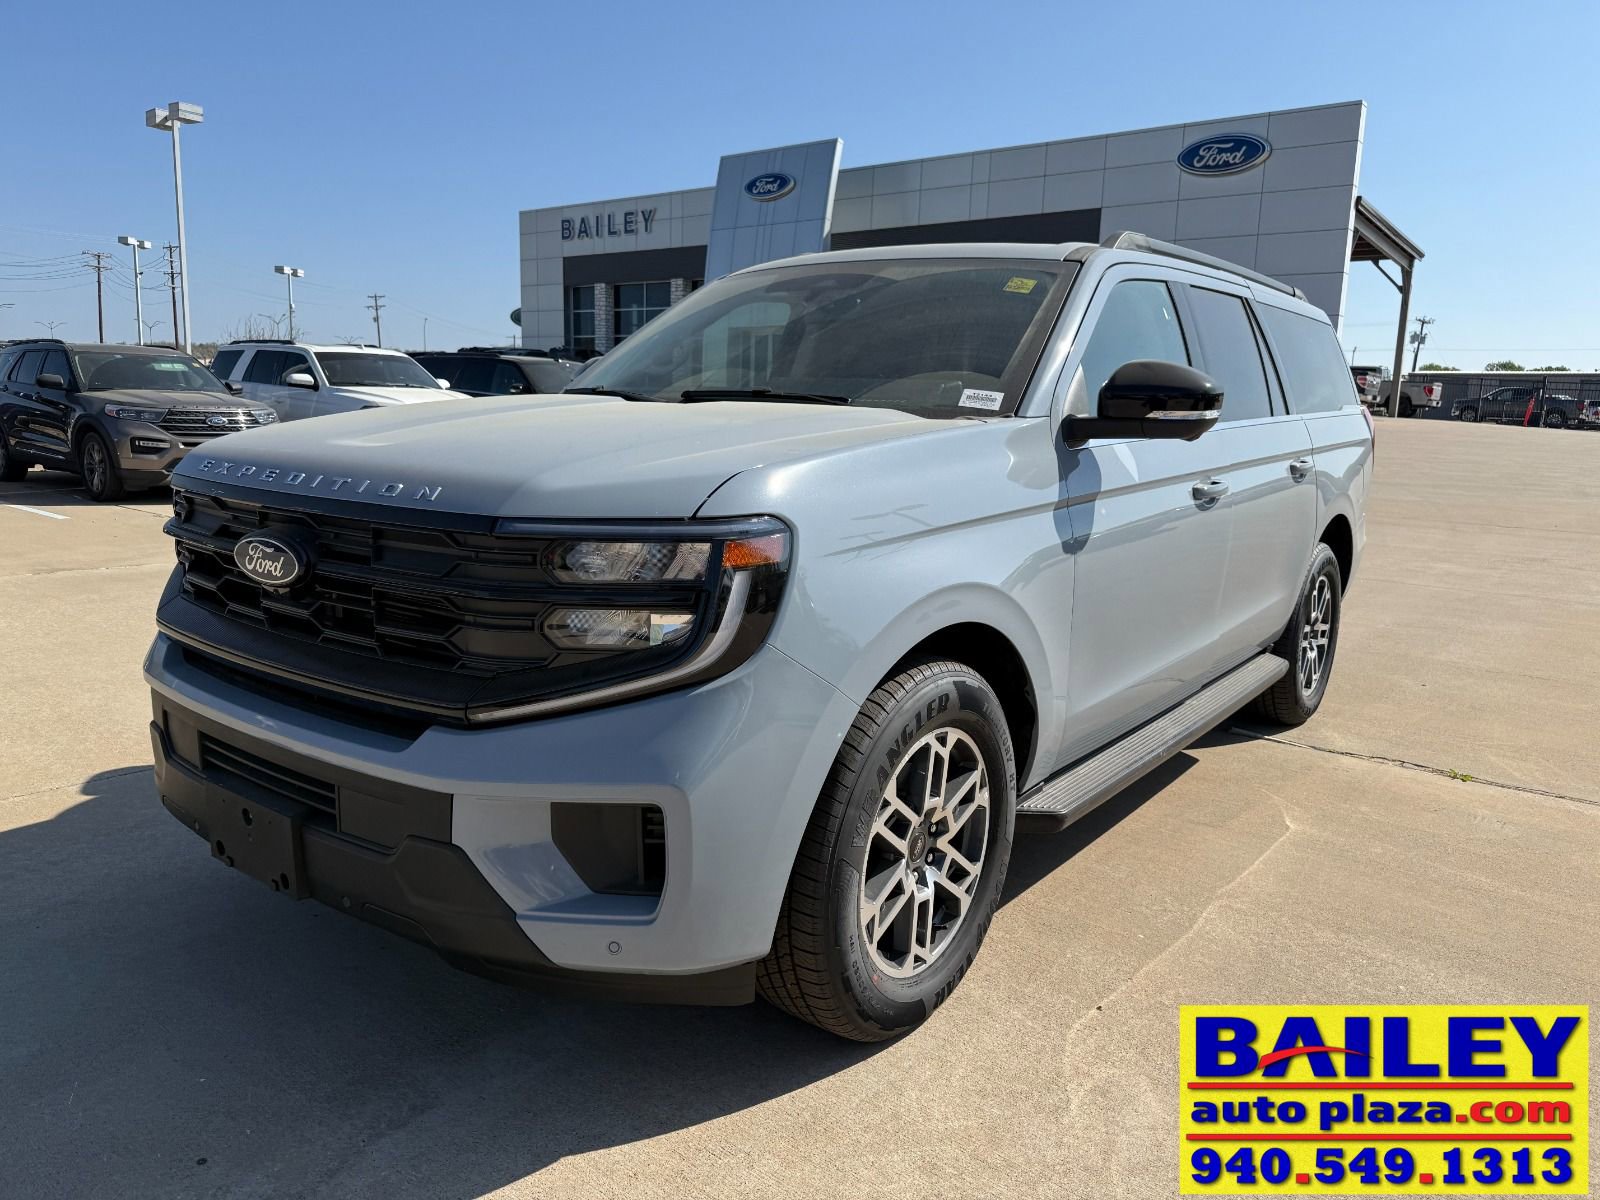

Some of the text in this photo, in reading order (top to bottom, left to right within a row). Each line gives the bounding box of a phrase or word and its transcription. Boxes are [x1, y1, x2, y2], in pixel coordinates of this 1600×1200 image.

[1194, 142, 1247, 168] Ford
[752, 178, 779, 194] Ford
[561, 208, 655, 240] BAILEY
[199, 459, 442, 501] EXPEDITION
[246, 543, 284, 577] Ford
[851, 692, 950, 847] WRANGLER
